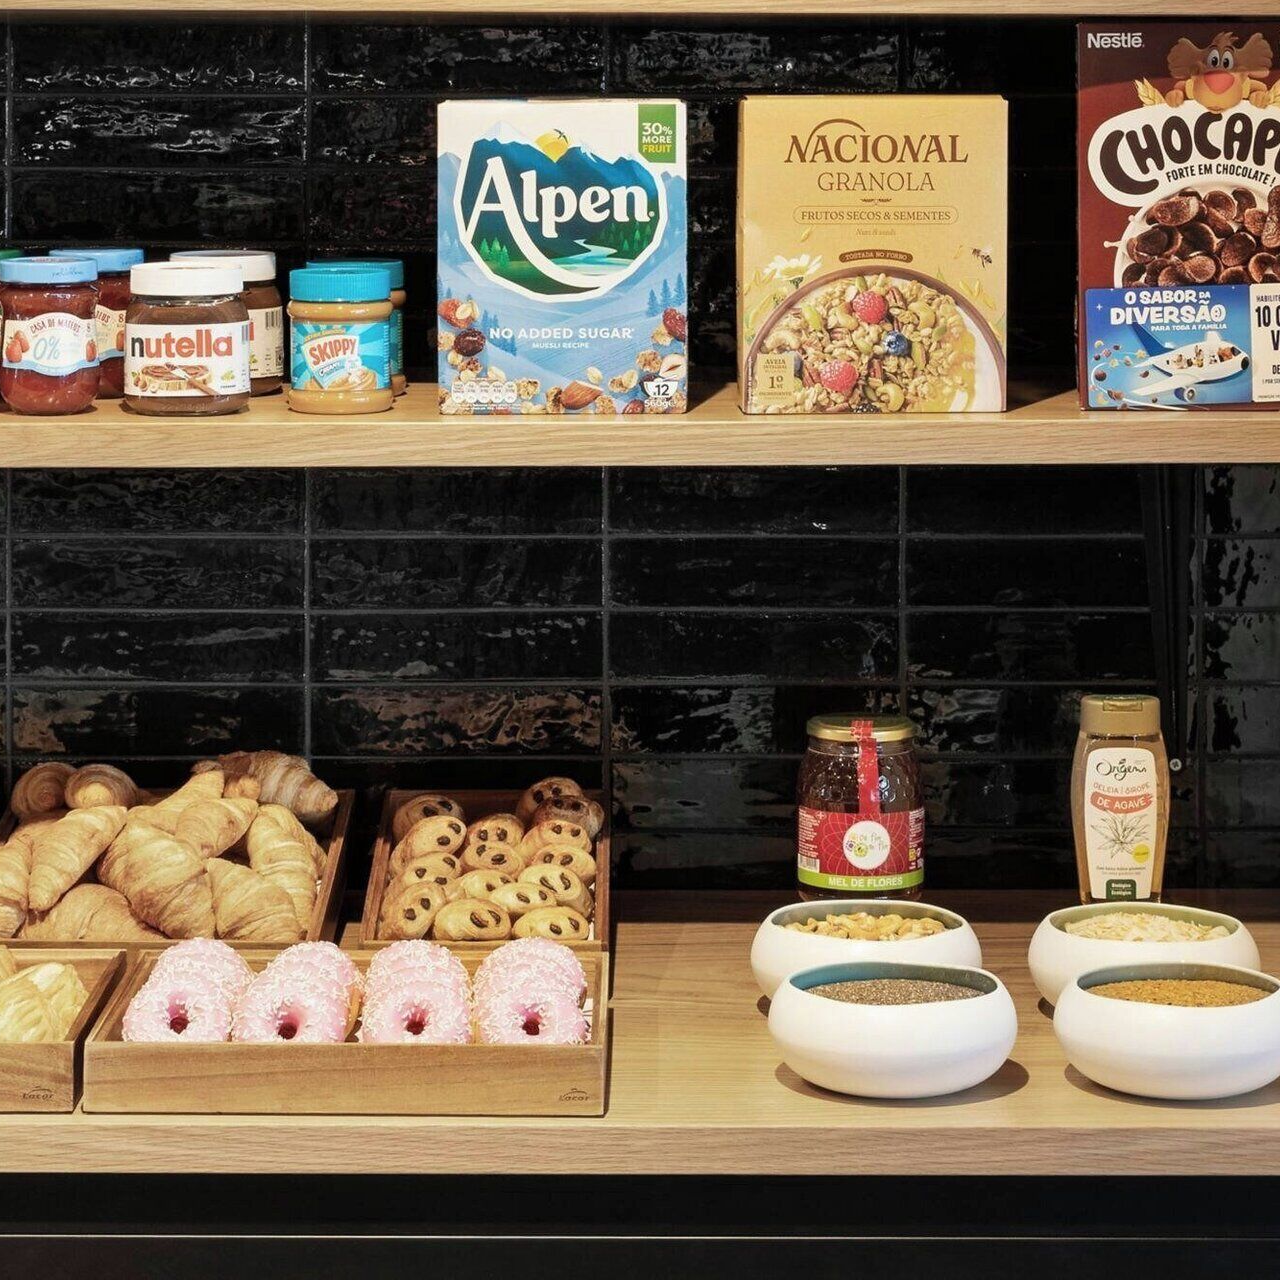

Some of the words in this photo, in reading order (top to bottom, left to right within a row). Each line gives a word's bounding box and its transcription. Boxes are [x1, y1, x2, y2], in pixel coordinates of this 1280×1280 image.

[642, 122, 673, 135] 30%
[642, 135, 672, 144] MORE
[784, 124, 969, 164] NACIONAL
[642, 144, 672, 154] FRUIT
[1165, 165, 1196, 183] FORTE
[1198, 163, 1213, 175] EM
[817, 172, 935, 192] GRANOLA
[467, 156, 652, 265] Alpen
[801, 211, 845, 220] FRUTOS
[846, 211, 881, 220] SECOS
[882, 211, 891, 220] &
[893, 211, 951, 220] SEMENTES
[1124, 291, 1137, 305] O
[1139, 289, 1198, 305] SABOR
[1199, 291, 1211, 299] DA
[1110, 300, 1227, 326] DIVERSÃO
[1255, 305, 1271, 327] 10
[30, 320, 47, 333] CASA
[48, 318, 56, 328] DE
[58, 318, 81, 333] MATEUS
[489, 327, 513, 339] NO
[518, 327, 571, 339] ADDED
[33, 336, 60, 360] 0%
[131, 329, 233, 358] nutella
[308, 338, 357, 366] SKIPPY
[1272, 365, 1280, 375] DE
[1096, 797, 1110, 808] DE
[1113, 796, 1145, 810] AGAVE
[828, 878, 848, 886] MEL
[851, 879, 864, 887] DE
[867, 876, 903, 887] FLORES
